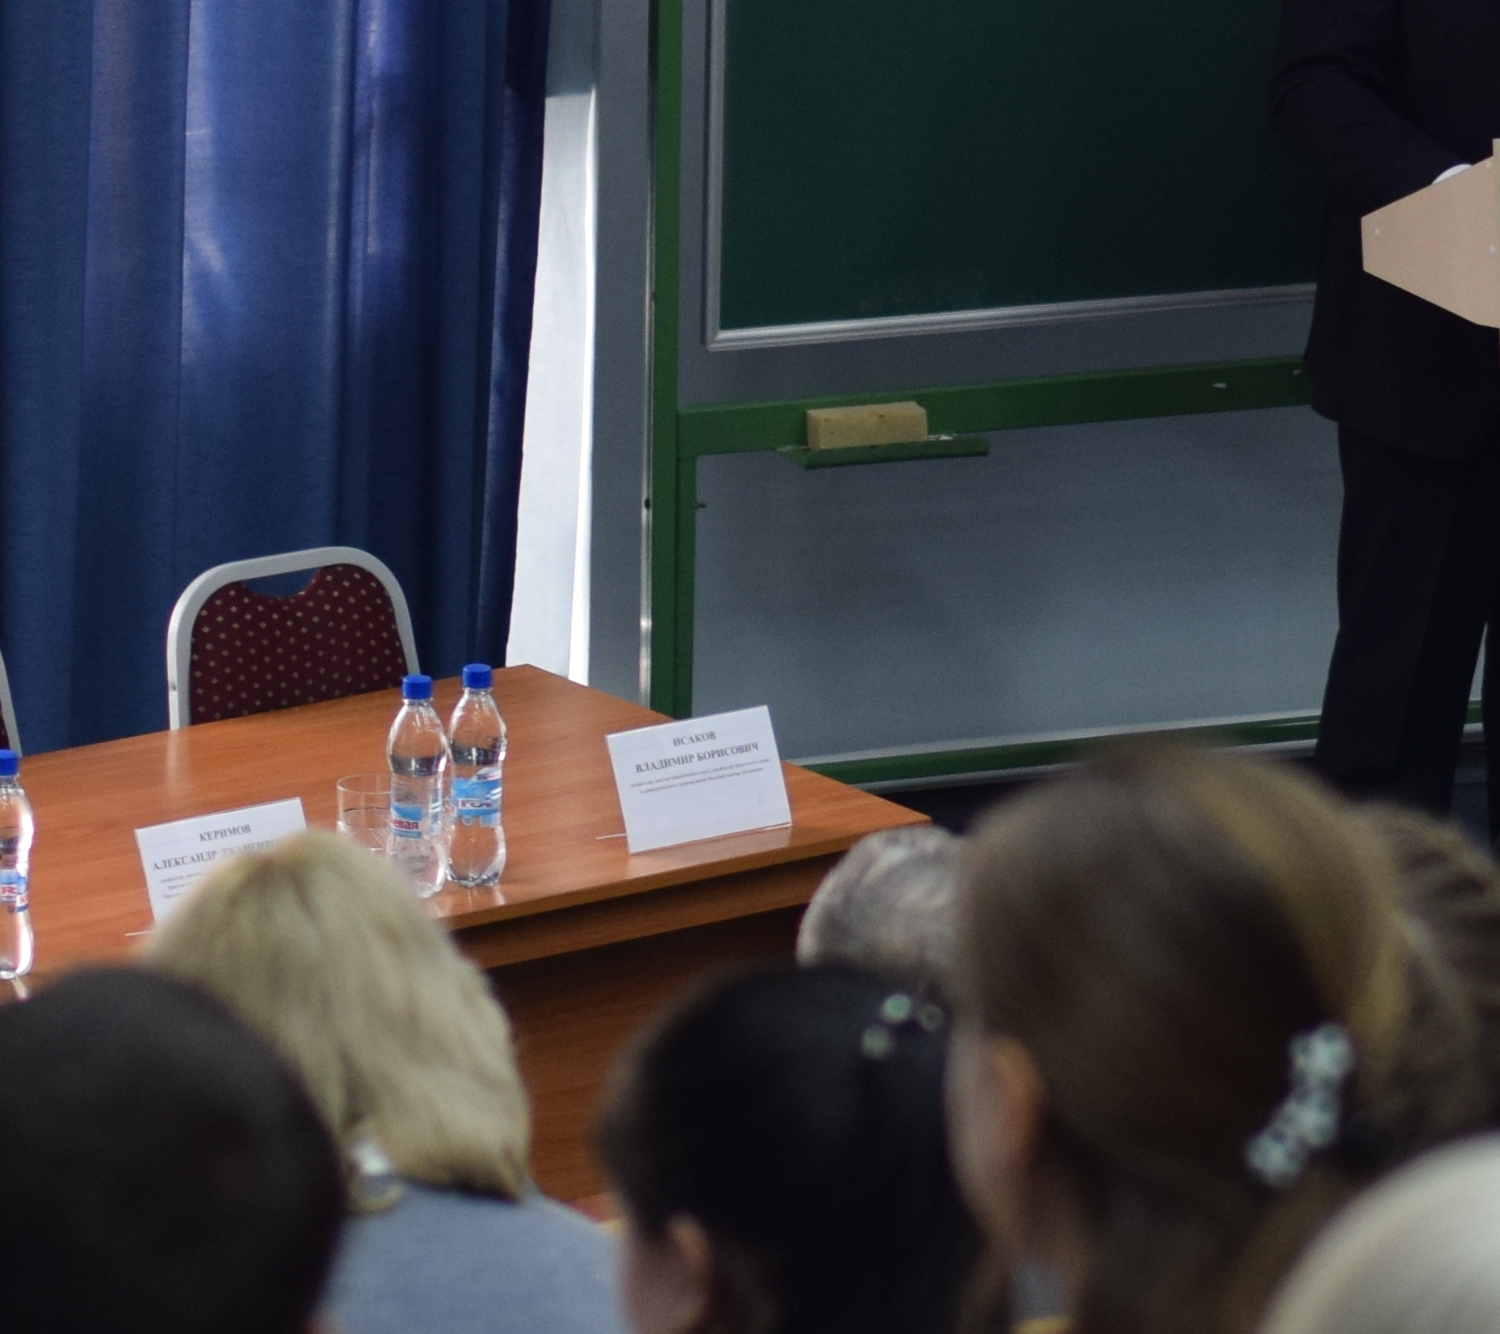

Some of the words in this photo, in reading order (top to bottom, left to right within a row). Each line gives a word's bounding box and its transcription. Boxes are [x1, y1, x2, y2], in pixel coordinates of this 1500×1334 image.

[673, 731, 717, 747] ИСАКОВ
[634, 754, 695, 774] ВЛАДИМИР
[697, 742, 759, 762] БОРИСОВИЧ
[199, 824, 252, 842] КЕРИМОВ
[153, 850, 218, 871] АЛЕКСАНДР
